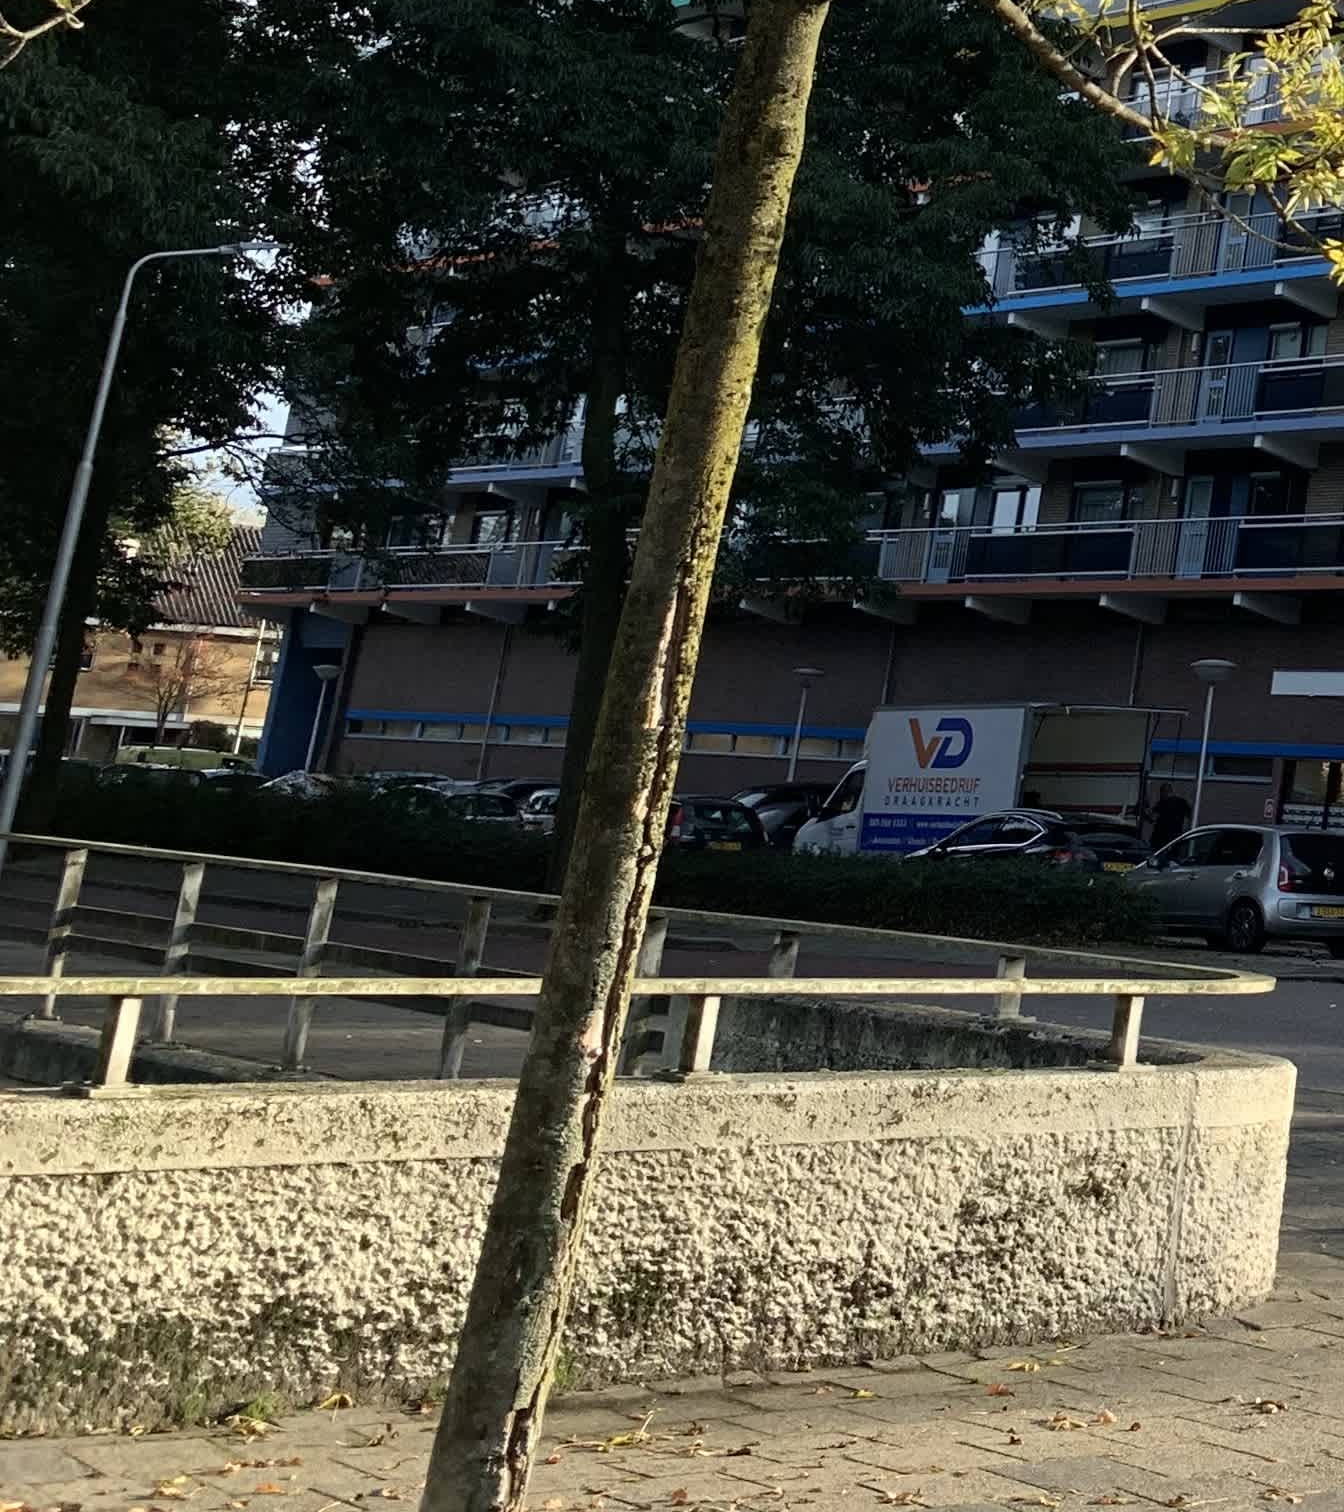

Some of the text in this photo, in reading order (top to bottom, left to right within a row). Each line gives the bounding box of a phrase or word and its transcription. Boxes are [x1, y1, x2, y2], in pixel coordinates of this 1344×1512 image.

[908, 718, 974, 769] VD
[887, 777, 982, 793] VERHUISBEDRIJF
[883, 795, 980, 808] DRAAGKRACHT
